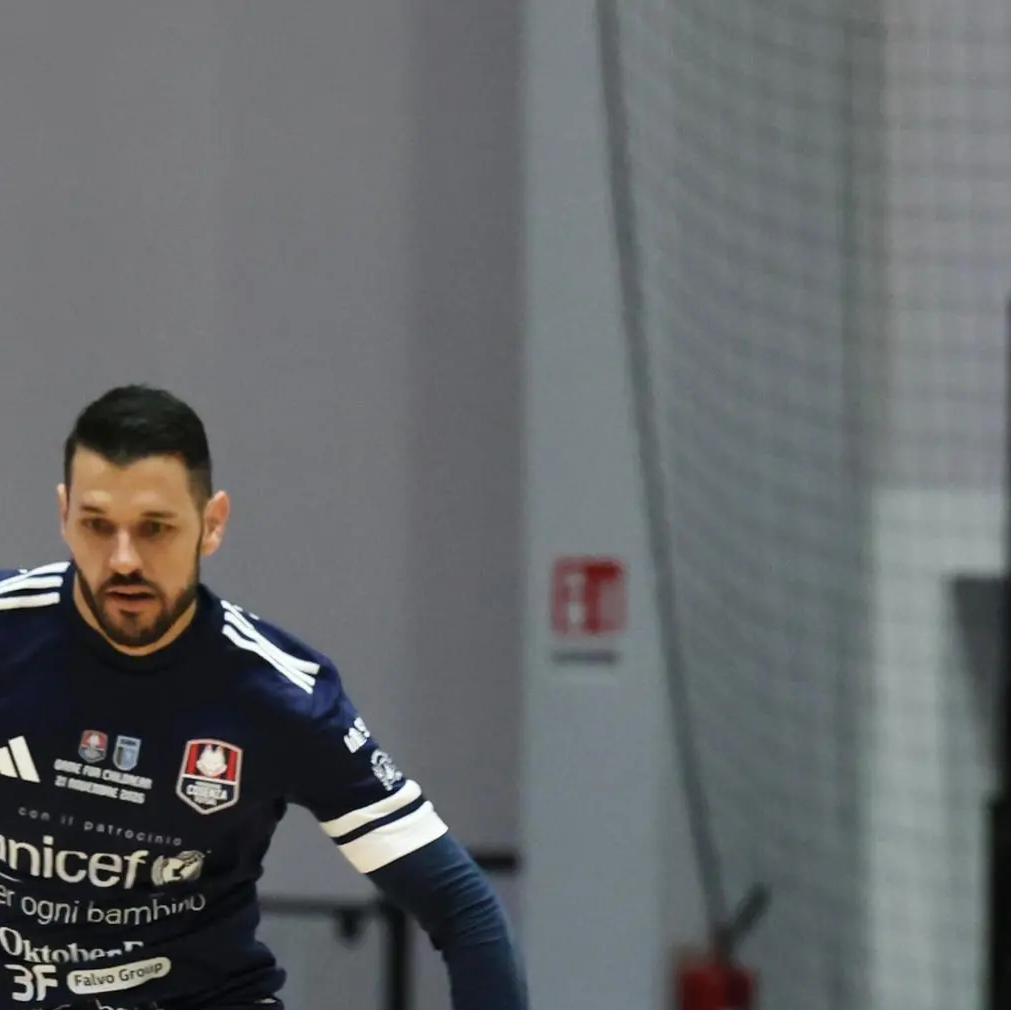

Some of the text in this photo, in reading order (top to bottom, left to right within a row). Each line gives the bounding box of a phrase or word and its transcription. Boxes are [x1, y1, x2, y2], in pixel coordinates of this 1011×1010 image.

[18, 807, 183, 846] con il patrocinio
[21, 896, 80, 925] ogni
[87, 893, 207, 925] bambino
[74, 973, 115, 987] Falvo
[119, 961, 163, 982] Group
